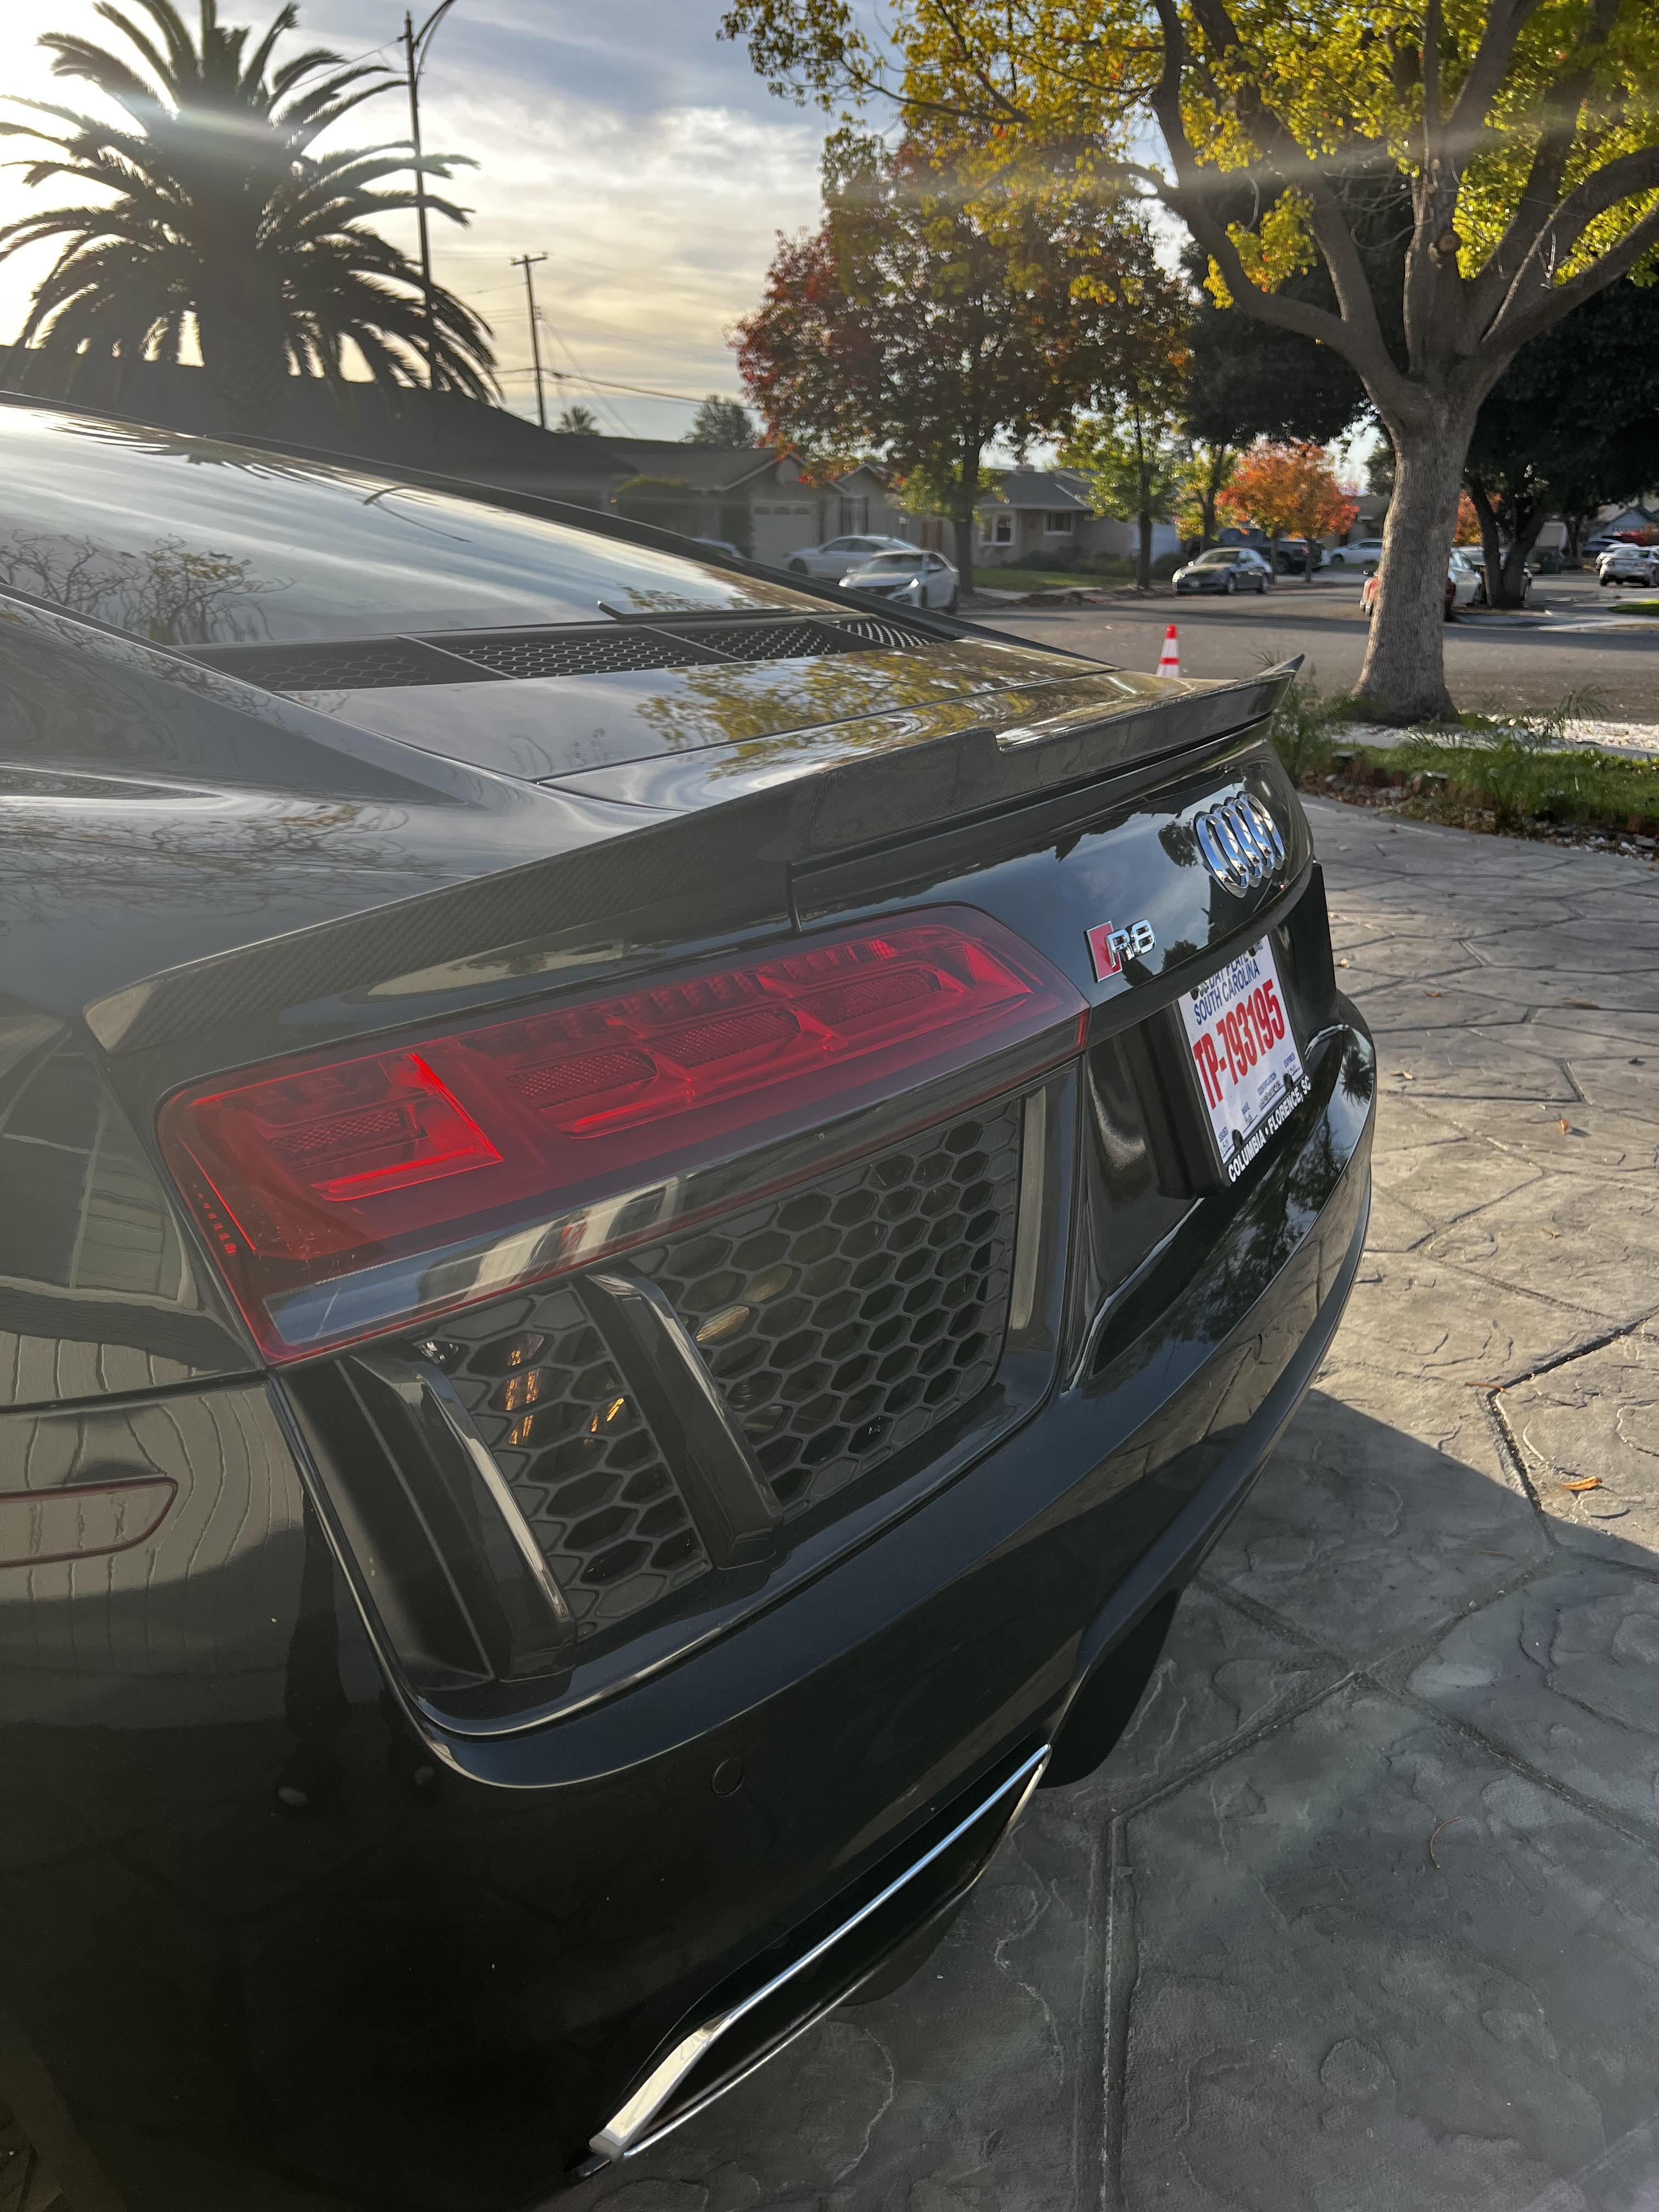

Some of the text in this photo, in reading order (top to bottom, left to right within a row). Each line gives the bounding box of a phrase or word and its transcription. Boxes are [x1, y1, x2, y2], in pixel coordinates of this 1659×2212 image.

[1105, 919, 1156, 968] R8
[1194, 958, 1260, 1025] SOUTH CAROLINA
[1192, 979, 1285, 1110] TP-793195
[1228, 1128, 1267, 1183] COLUMBIA
[1301, 1075, 1311, 1096] SC
